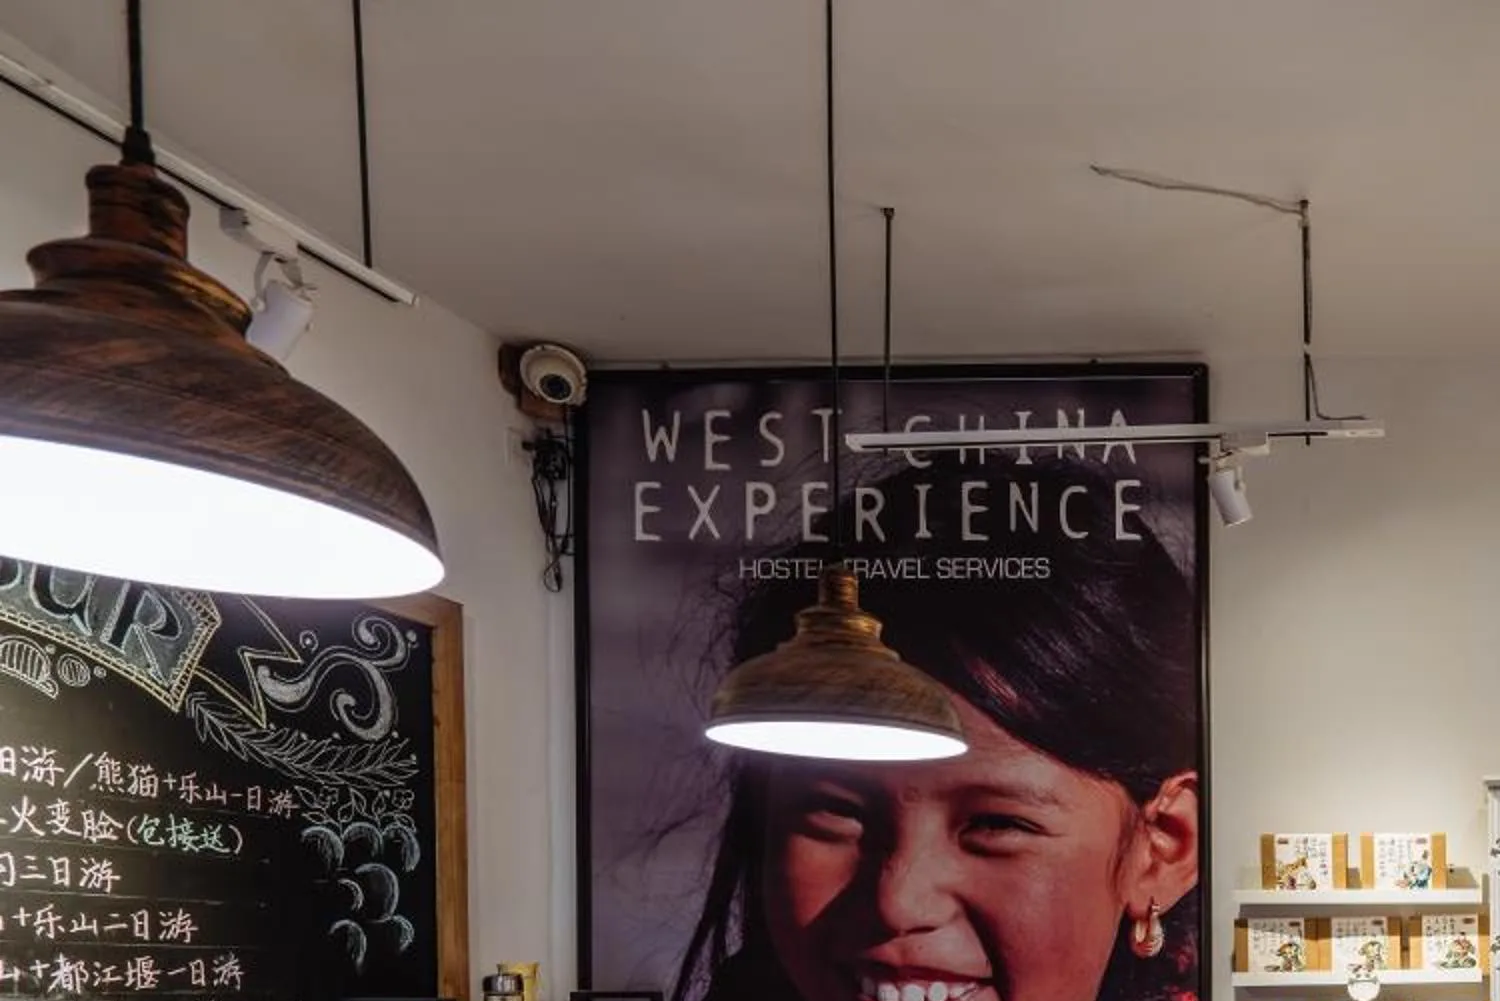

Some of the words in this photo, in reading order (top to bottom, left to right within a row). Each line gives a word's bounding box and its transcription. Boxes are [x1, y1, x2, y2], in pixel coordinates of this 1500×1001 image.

[641, 407, 842, 471] WEST
[902, 407, 1139, 470] CHINA
[633, 478, 1143, 543] EXPERIENCE
[935, 556, 1051, 581] SERVICES
[0, 796, 243, 855] 火变脸(包接送)
[0, 902, 199, 944] +乐山二日游
